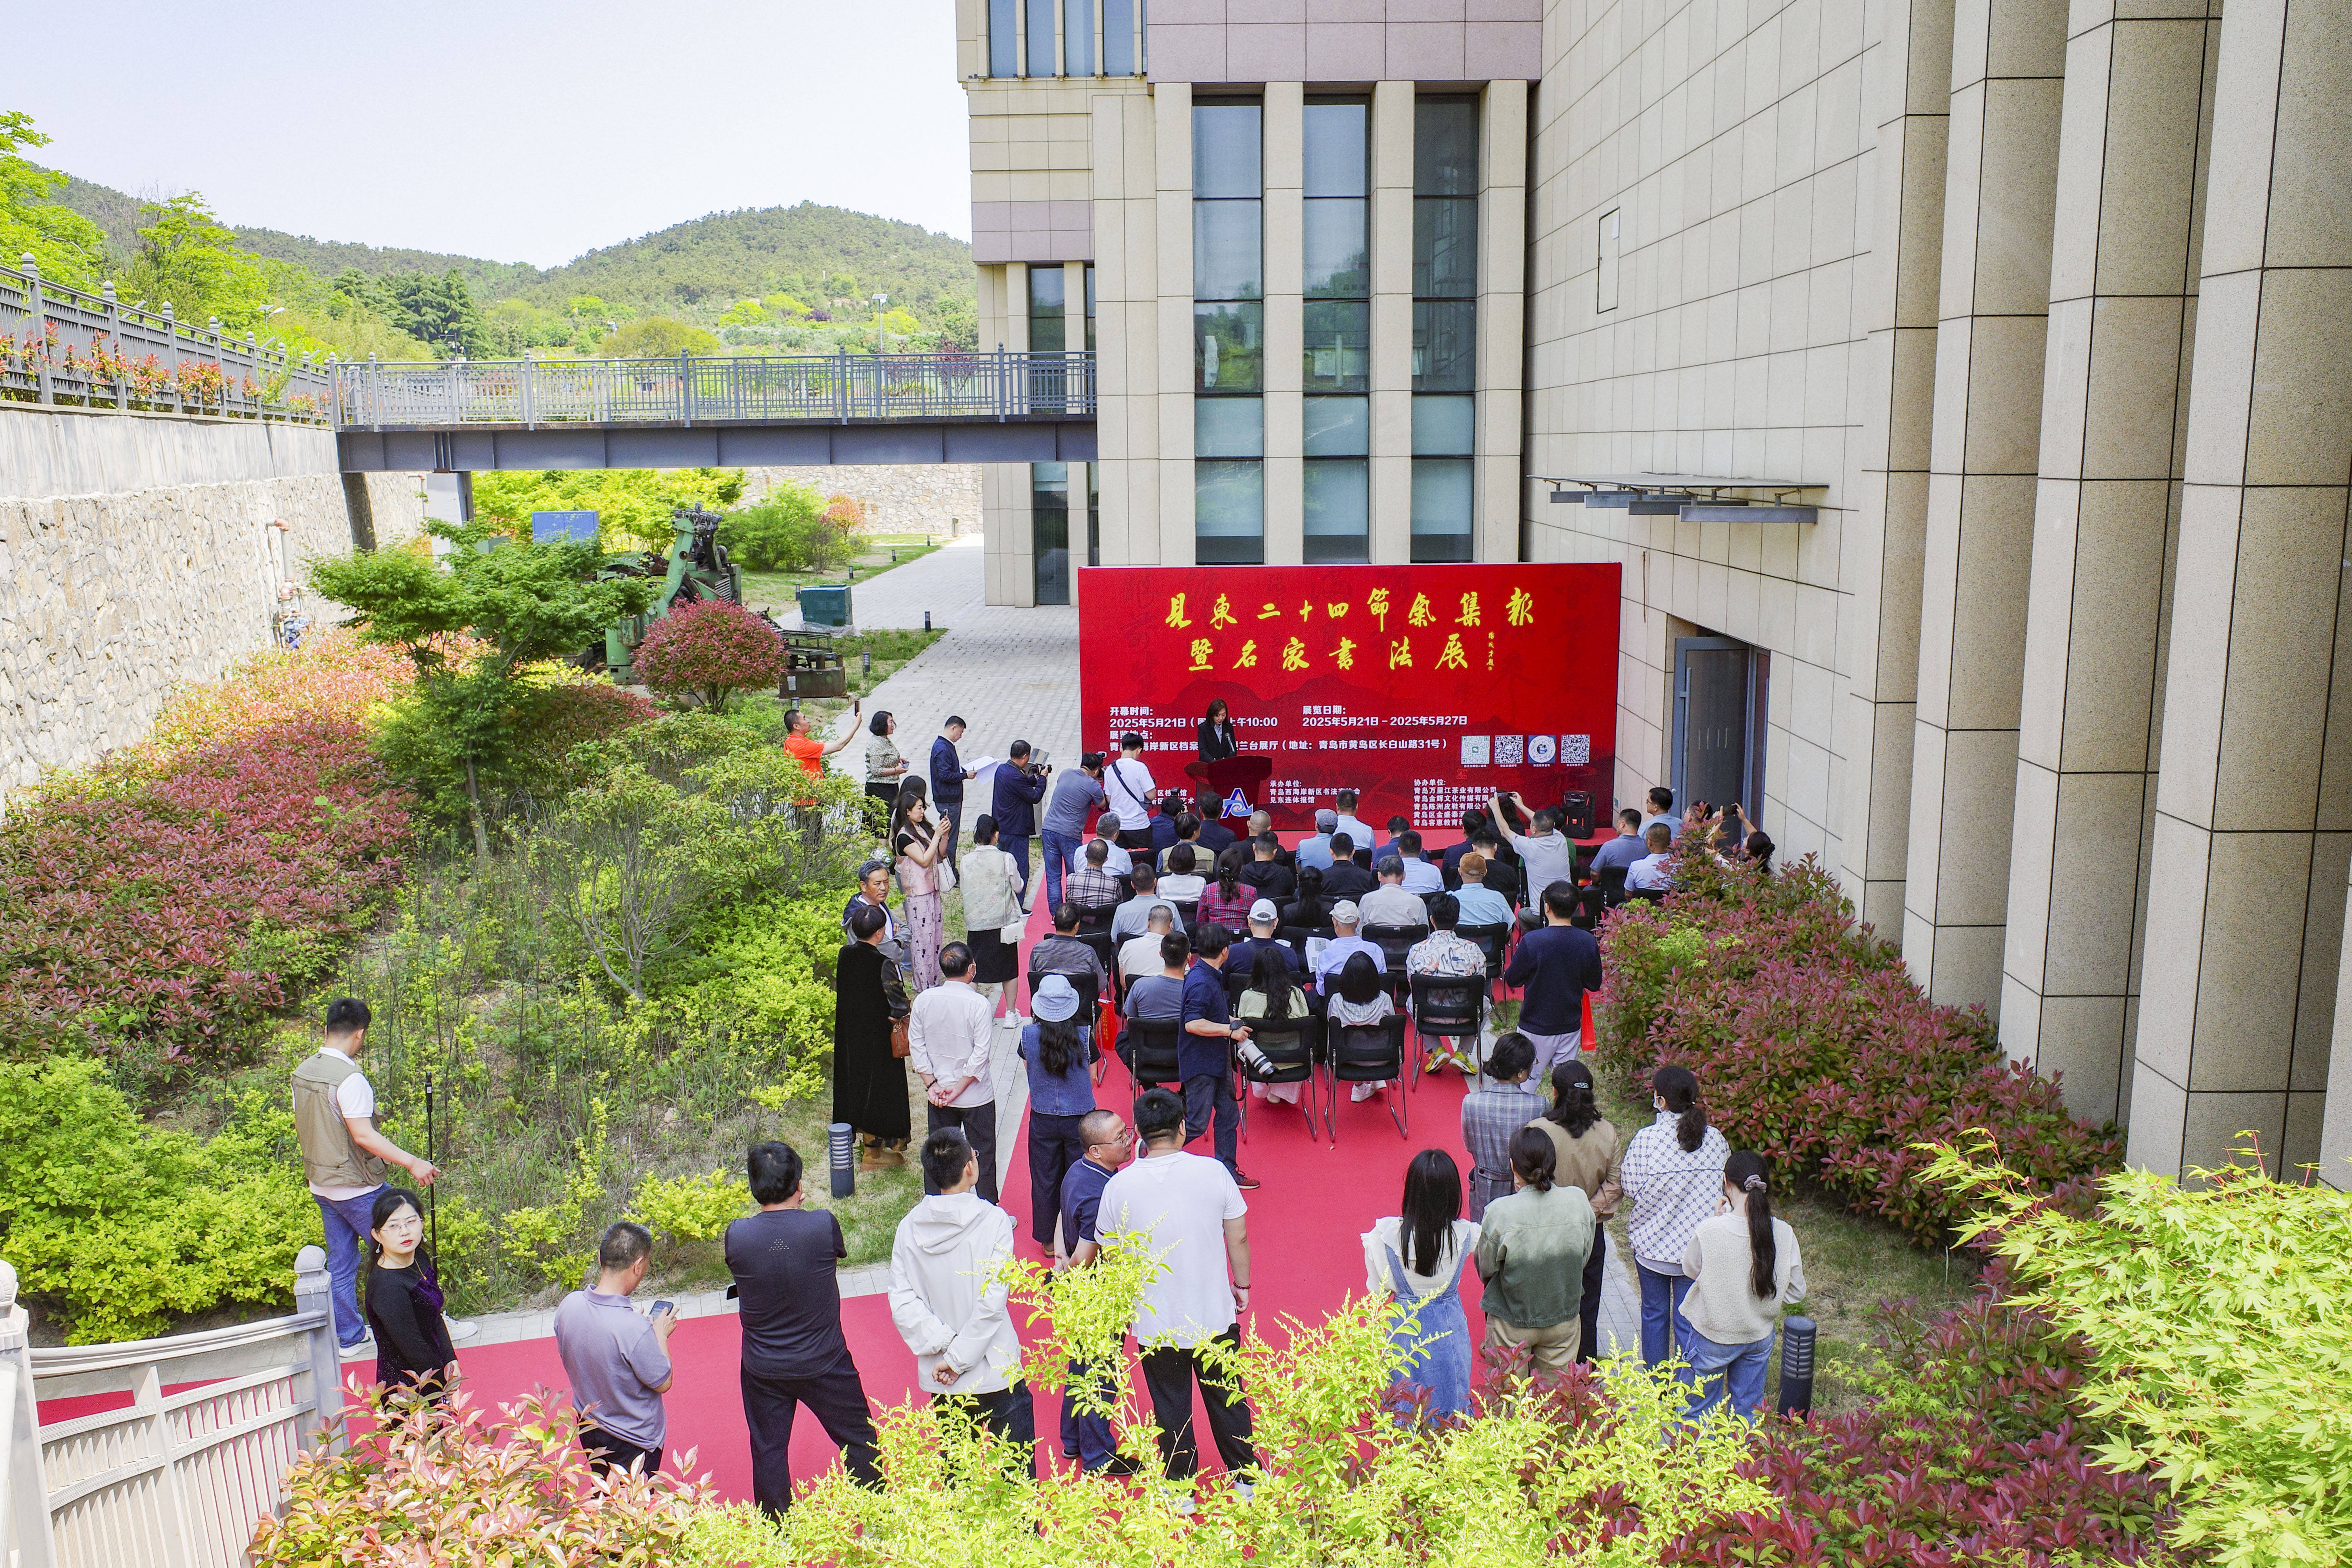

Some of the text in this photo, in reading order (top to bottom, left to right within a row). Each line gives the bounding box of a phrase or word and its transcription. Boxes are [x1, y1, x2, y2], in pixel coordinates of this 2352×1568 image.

[1110, 706, 1153, 716] 开幕时间：
[1302, 705, 1346, 715] 展览日期：
[1413, 778, 1446, 786] 协办单位：
[1269, 788, 1361, 796] 青岛西海岸新区书法会
[1413, 786, 1497, 794] 青岛万里江茶业有限公司
